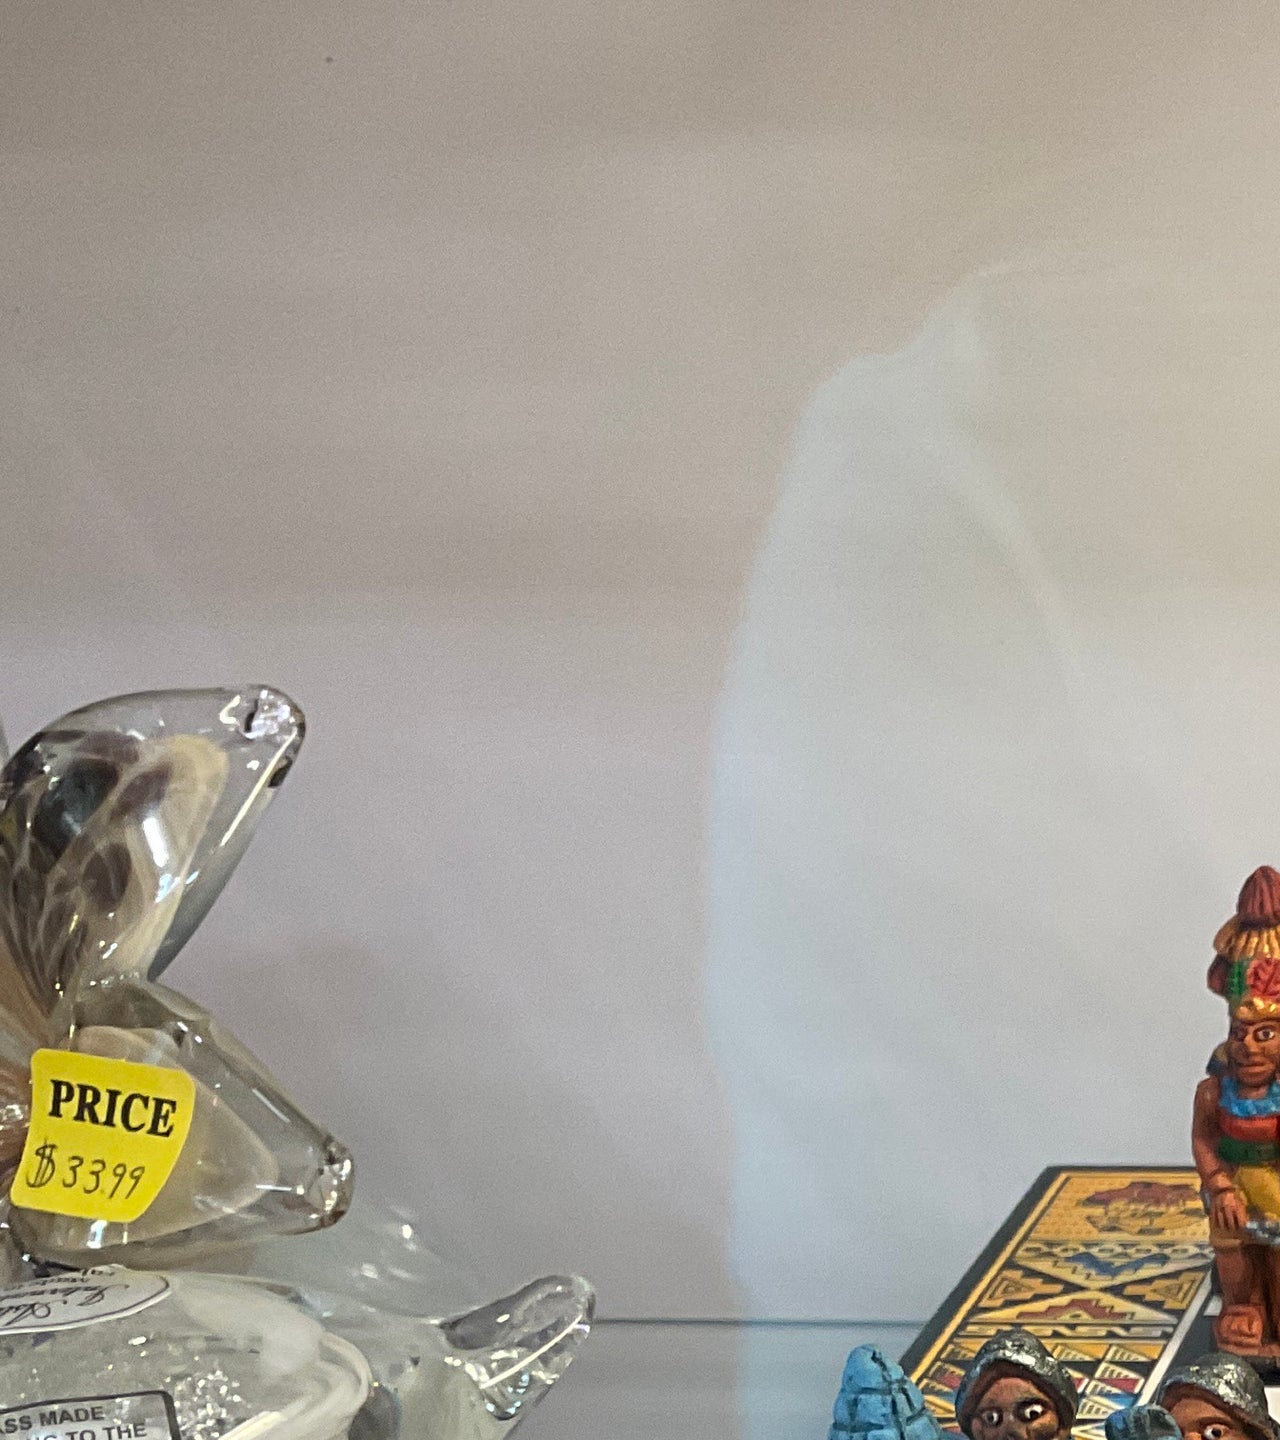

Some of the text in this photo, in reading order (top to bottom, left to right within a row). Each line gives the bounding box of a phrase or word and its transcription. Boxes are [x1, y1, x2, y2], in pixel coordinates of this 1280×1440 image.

[48, 1079, 177, 1137] PRICE
[39, 1406, 105, 1426] MADE
[103, 1422, 147, 1440] THE
